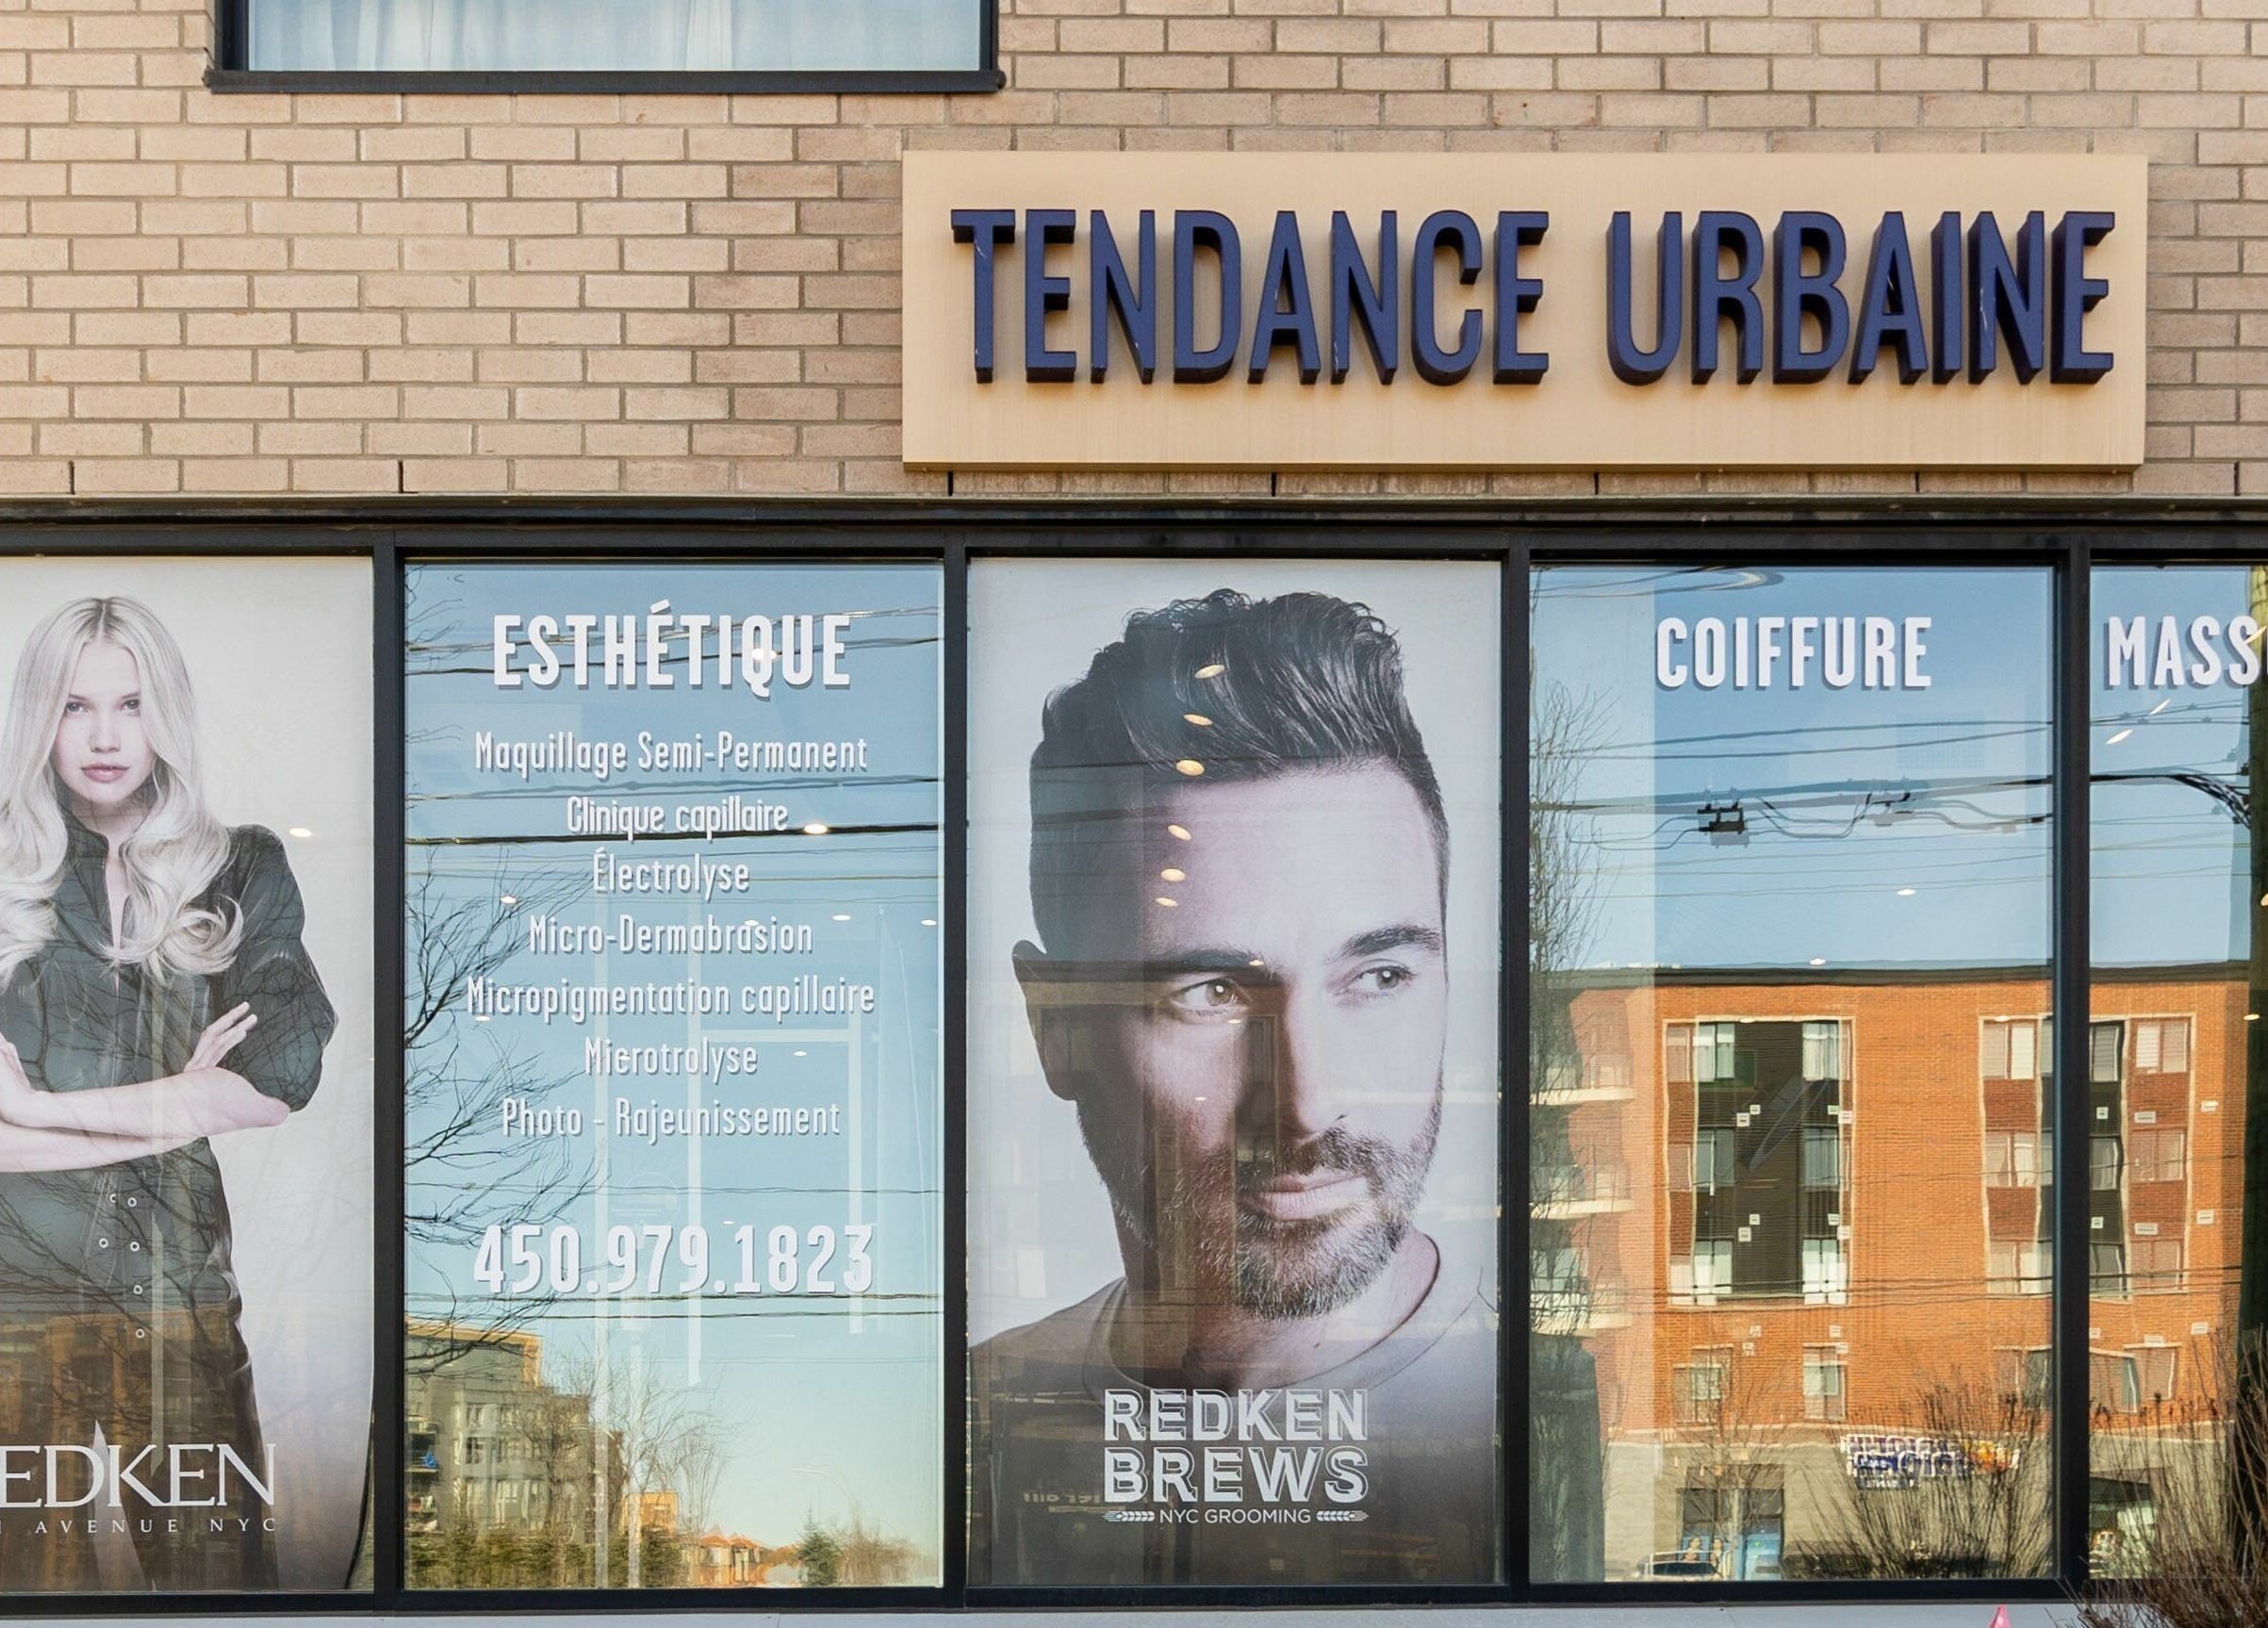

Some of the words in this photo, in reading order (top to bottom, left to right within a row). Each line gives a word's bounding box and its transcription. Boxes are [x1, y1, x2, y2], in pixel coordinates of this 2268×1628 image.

[950, 208, 1550, 385] TENDANCE
[1607, 209, 2116, 386] URBAINE
[493, 599, 851, 698] ESTHÉTIQUE
[1656, 617, 1932, 689] COIFFURE
[475, 731, 628, 781] Maquillage
[637, 731, 868, 771] Semi-Permanent
[567, 795, 666, 843] Clinique
[675, 794, 789, 843] capillaire
[593, 847, 750, 902] Électrolyse
[529, 914, 814, 954] Micro-Dermabrasion
[467, 977, 731, 1024] Micropigmentation
[741, 975, 876, 1024] capillaire
[584, 1039, 759, 1084] Microtrolyse
[502, 1097, 583, 1136] Photo
[616, 1097, 840, 1144] Rajeunissement
[473, 1224, 875, 1295] 450.979.1823
[1104, 1389, 1369, 1441] REDKEN
[1104, 1445, 1369, 1504] BREWS
[35, 1519, 179, 1534] AVENUE
[210, 1517, 276, 1533] NYC
[1159, 1508, 1199, 1524] NYC
[1204, 1508, 1311, 1524] GROOMING
